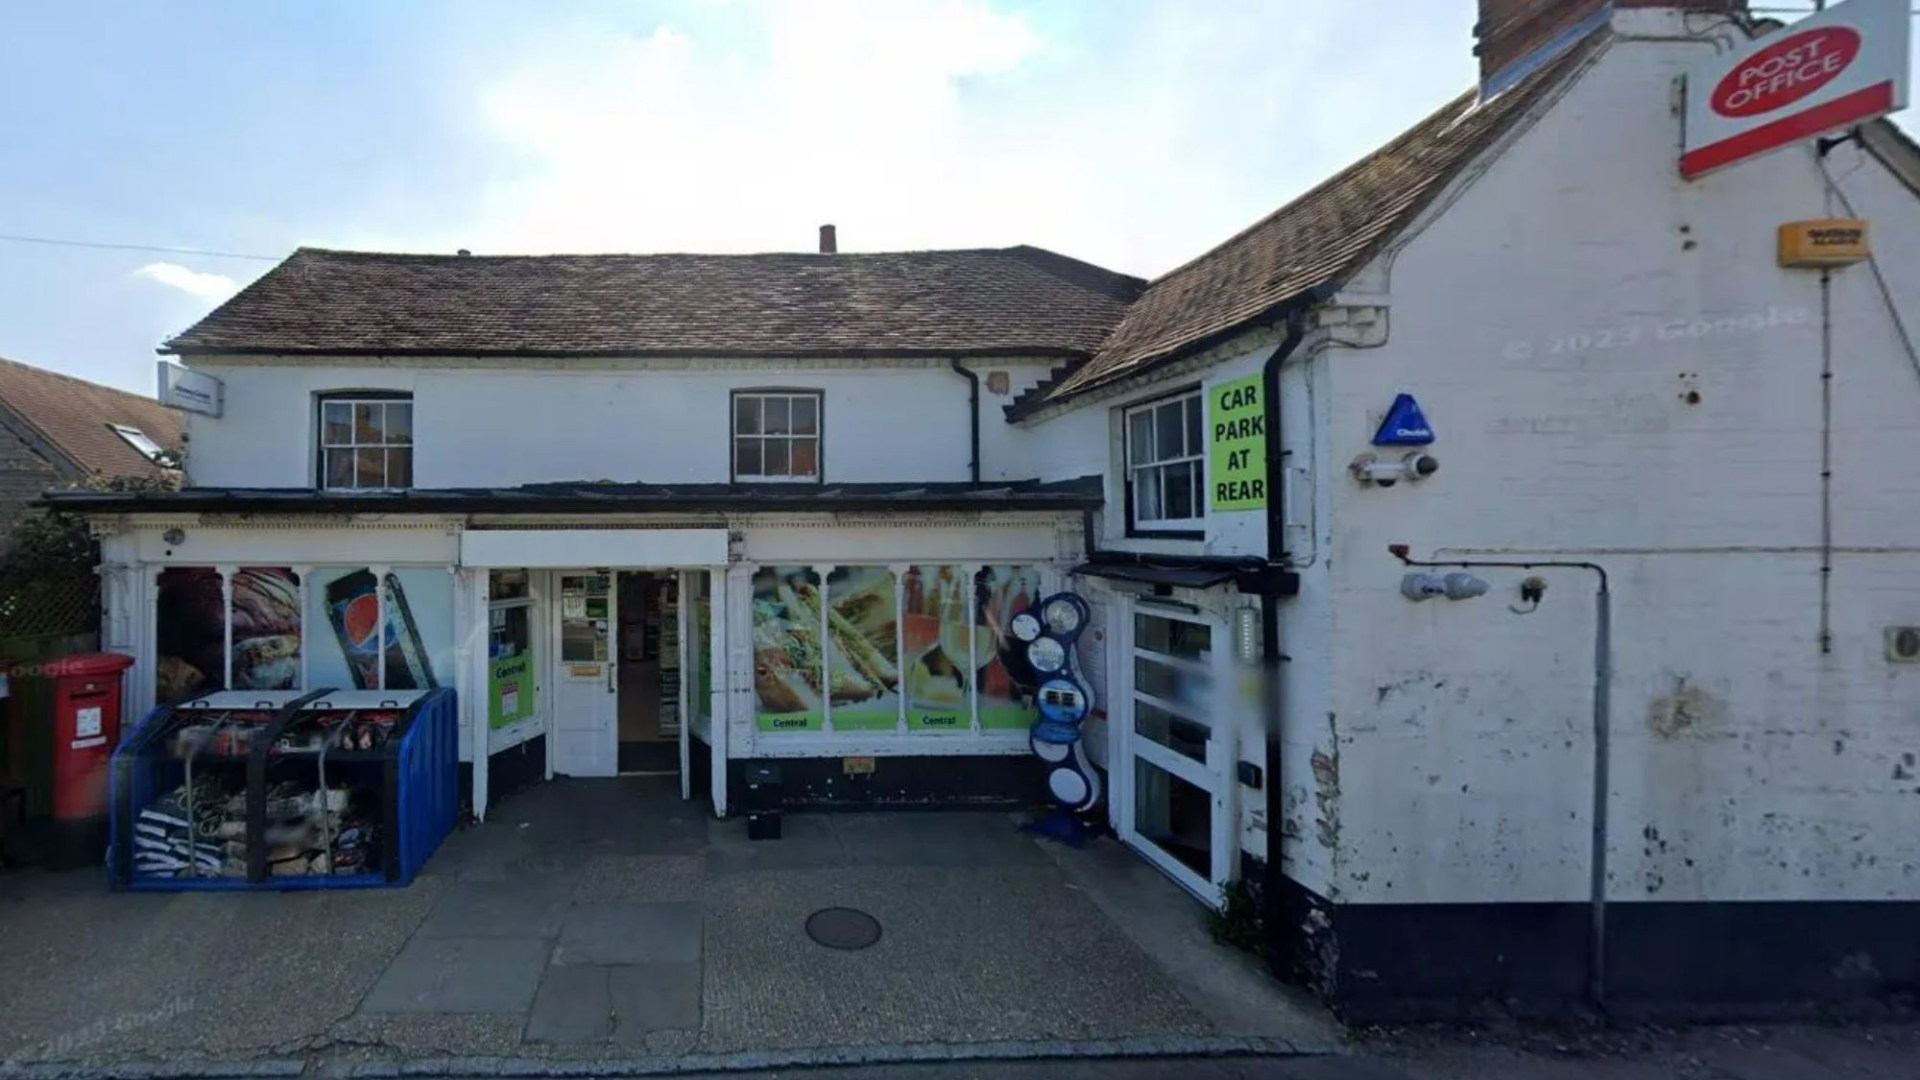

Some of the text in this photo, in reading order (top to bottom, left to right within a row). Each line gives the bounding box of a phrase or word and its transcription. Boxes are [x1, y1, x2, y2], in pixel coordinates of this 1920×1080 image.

[1741, 36, 1828, 84] POST
[1725, 48, 1844, 109] OFFICE
[1220, 385, 1257, 411] CAR
[1215, 414, 1264, 443] PARK
[1227, 448, 1251, 471] AT
[1216, 479, 1265, 502] REAR
[773, 718, 808, 729] Central
[922, 715, 957, 727] Central
